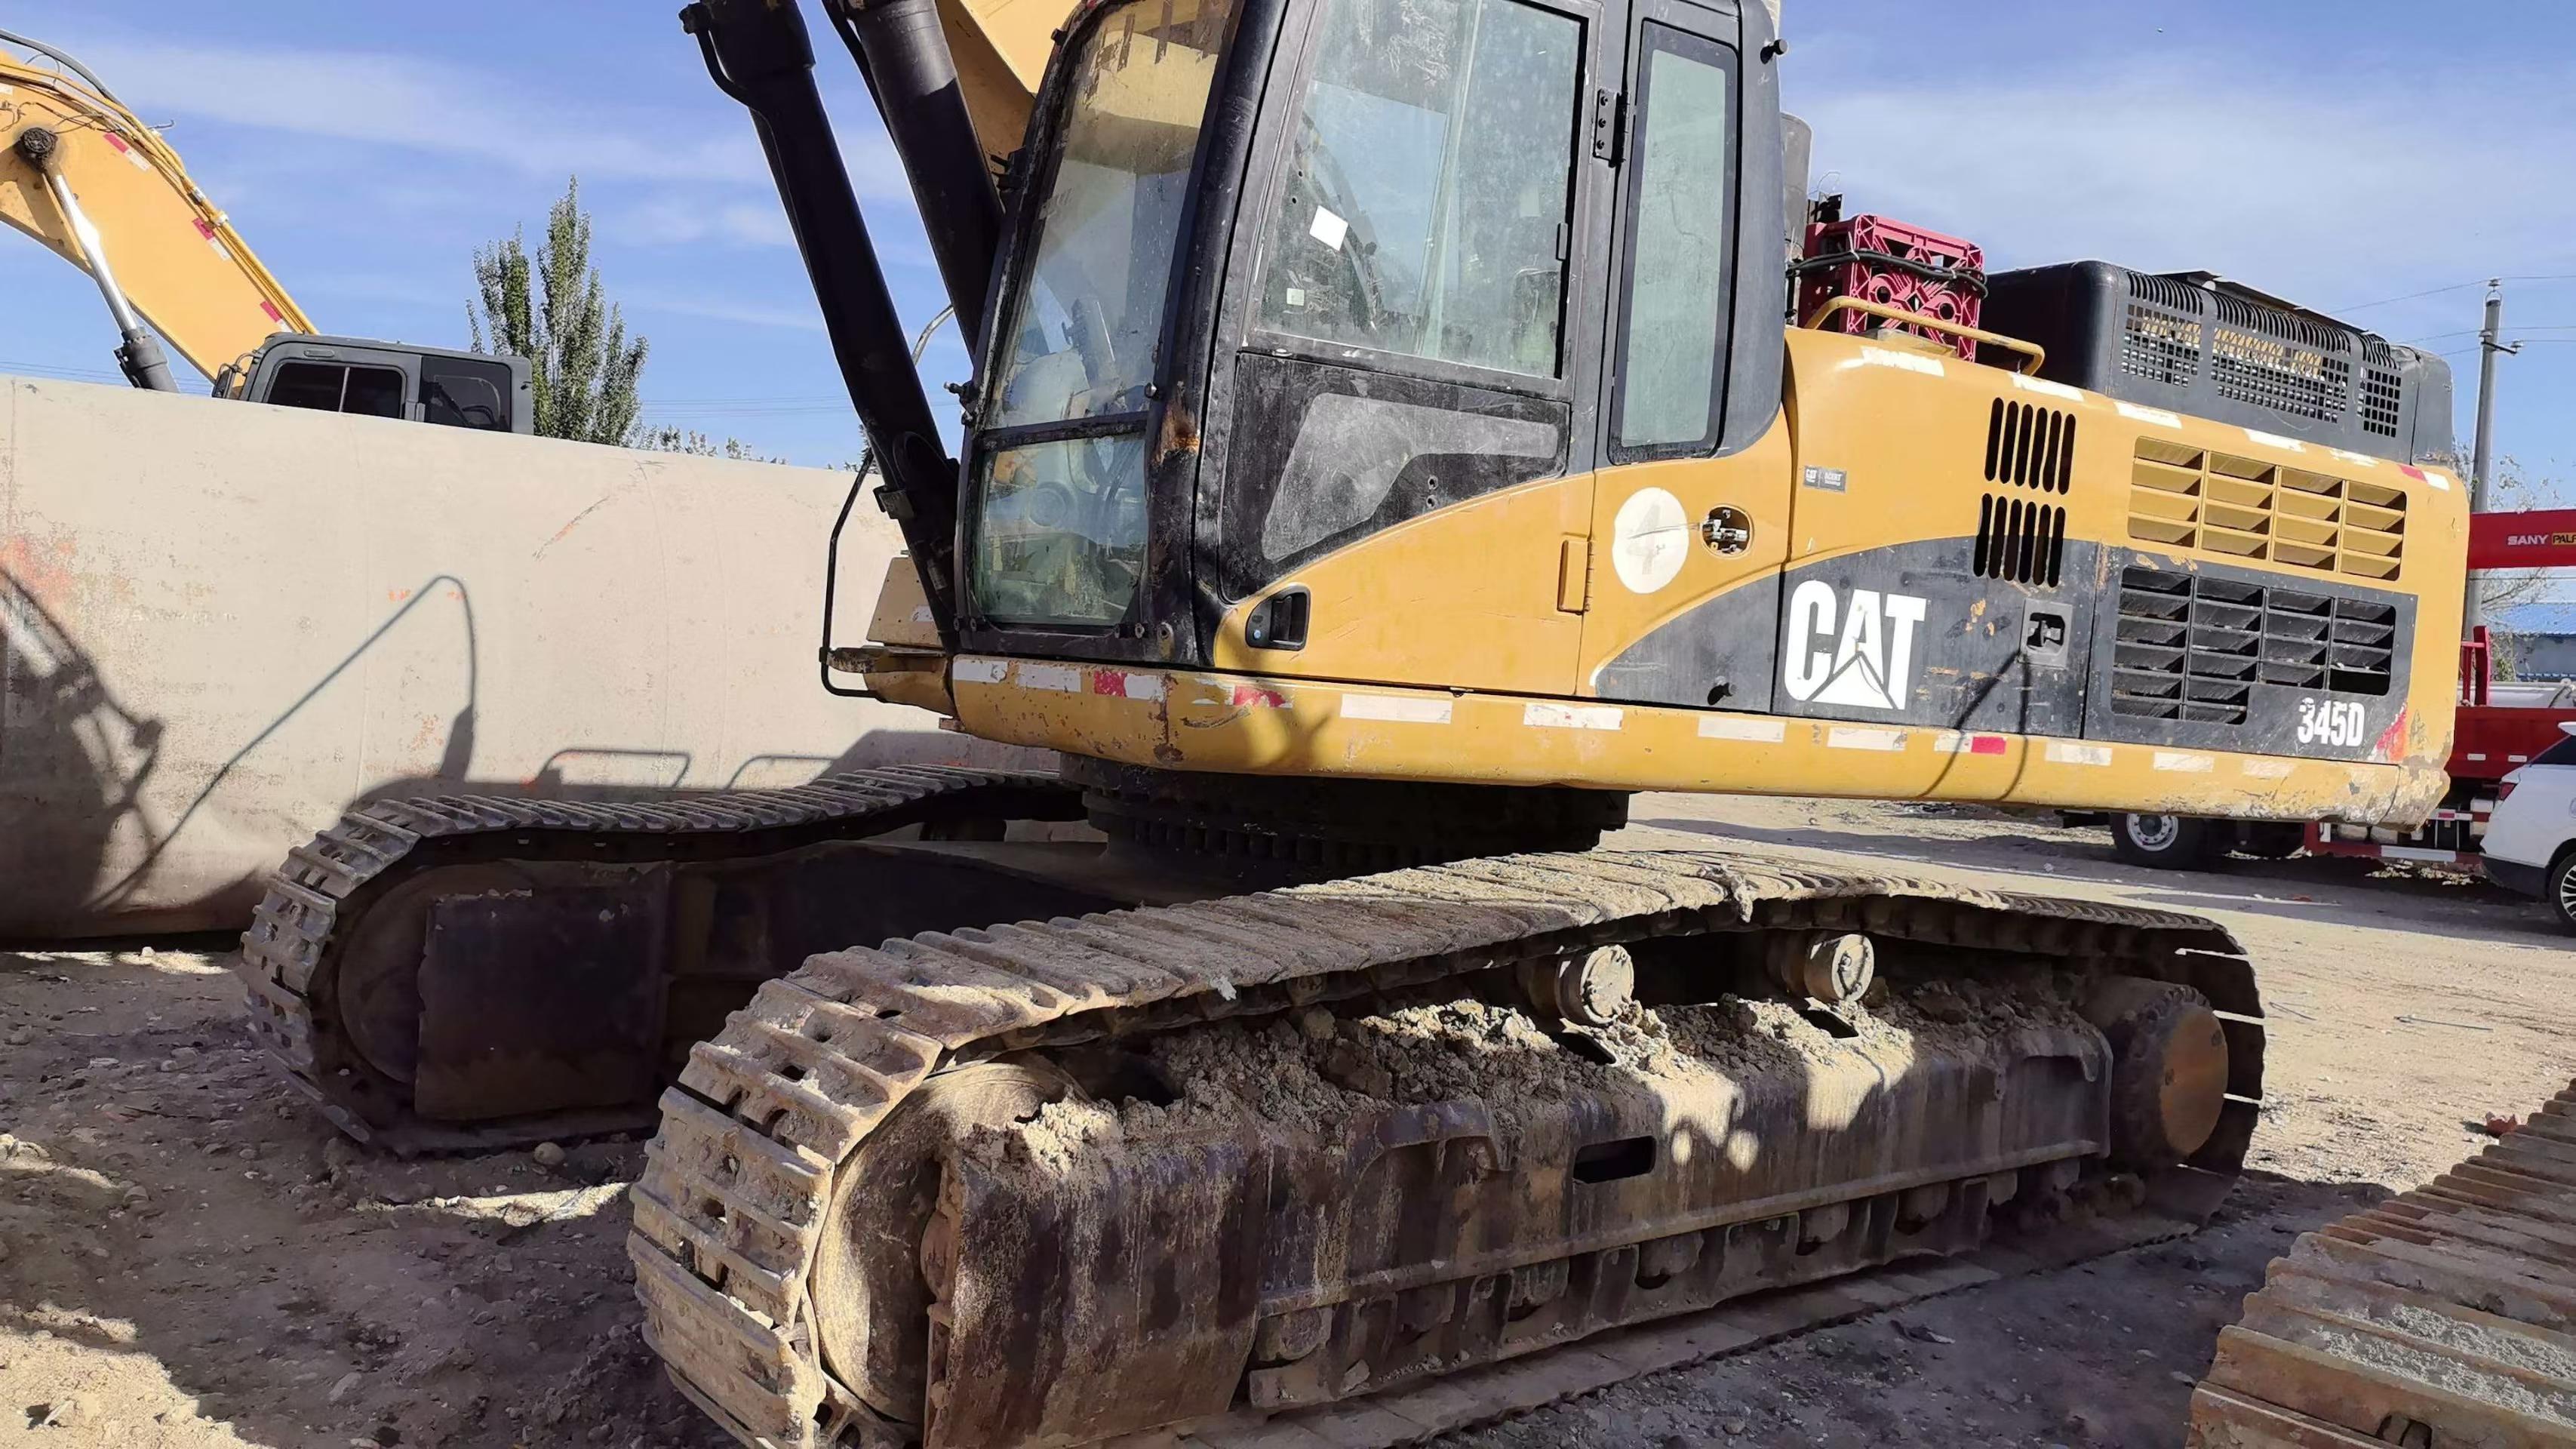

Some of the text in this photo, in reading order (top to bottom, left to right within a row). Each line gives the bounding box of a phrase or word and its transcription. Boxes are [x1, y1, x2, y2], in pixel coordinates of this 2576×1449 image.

[2507, 534, 2549, 546] SANY
[1784, 580, 1926, 710] CAT
[2298, 697, 2365, 746] 345D
